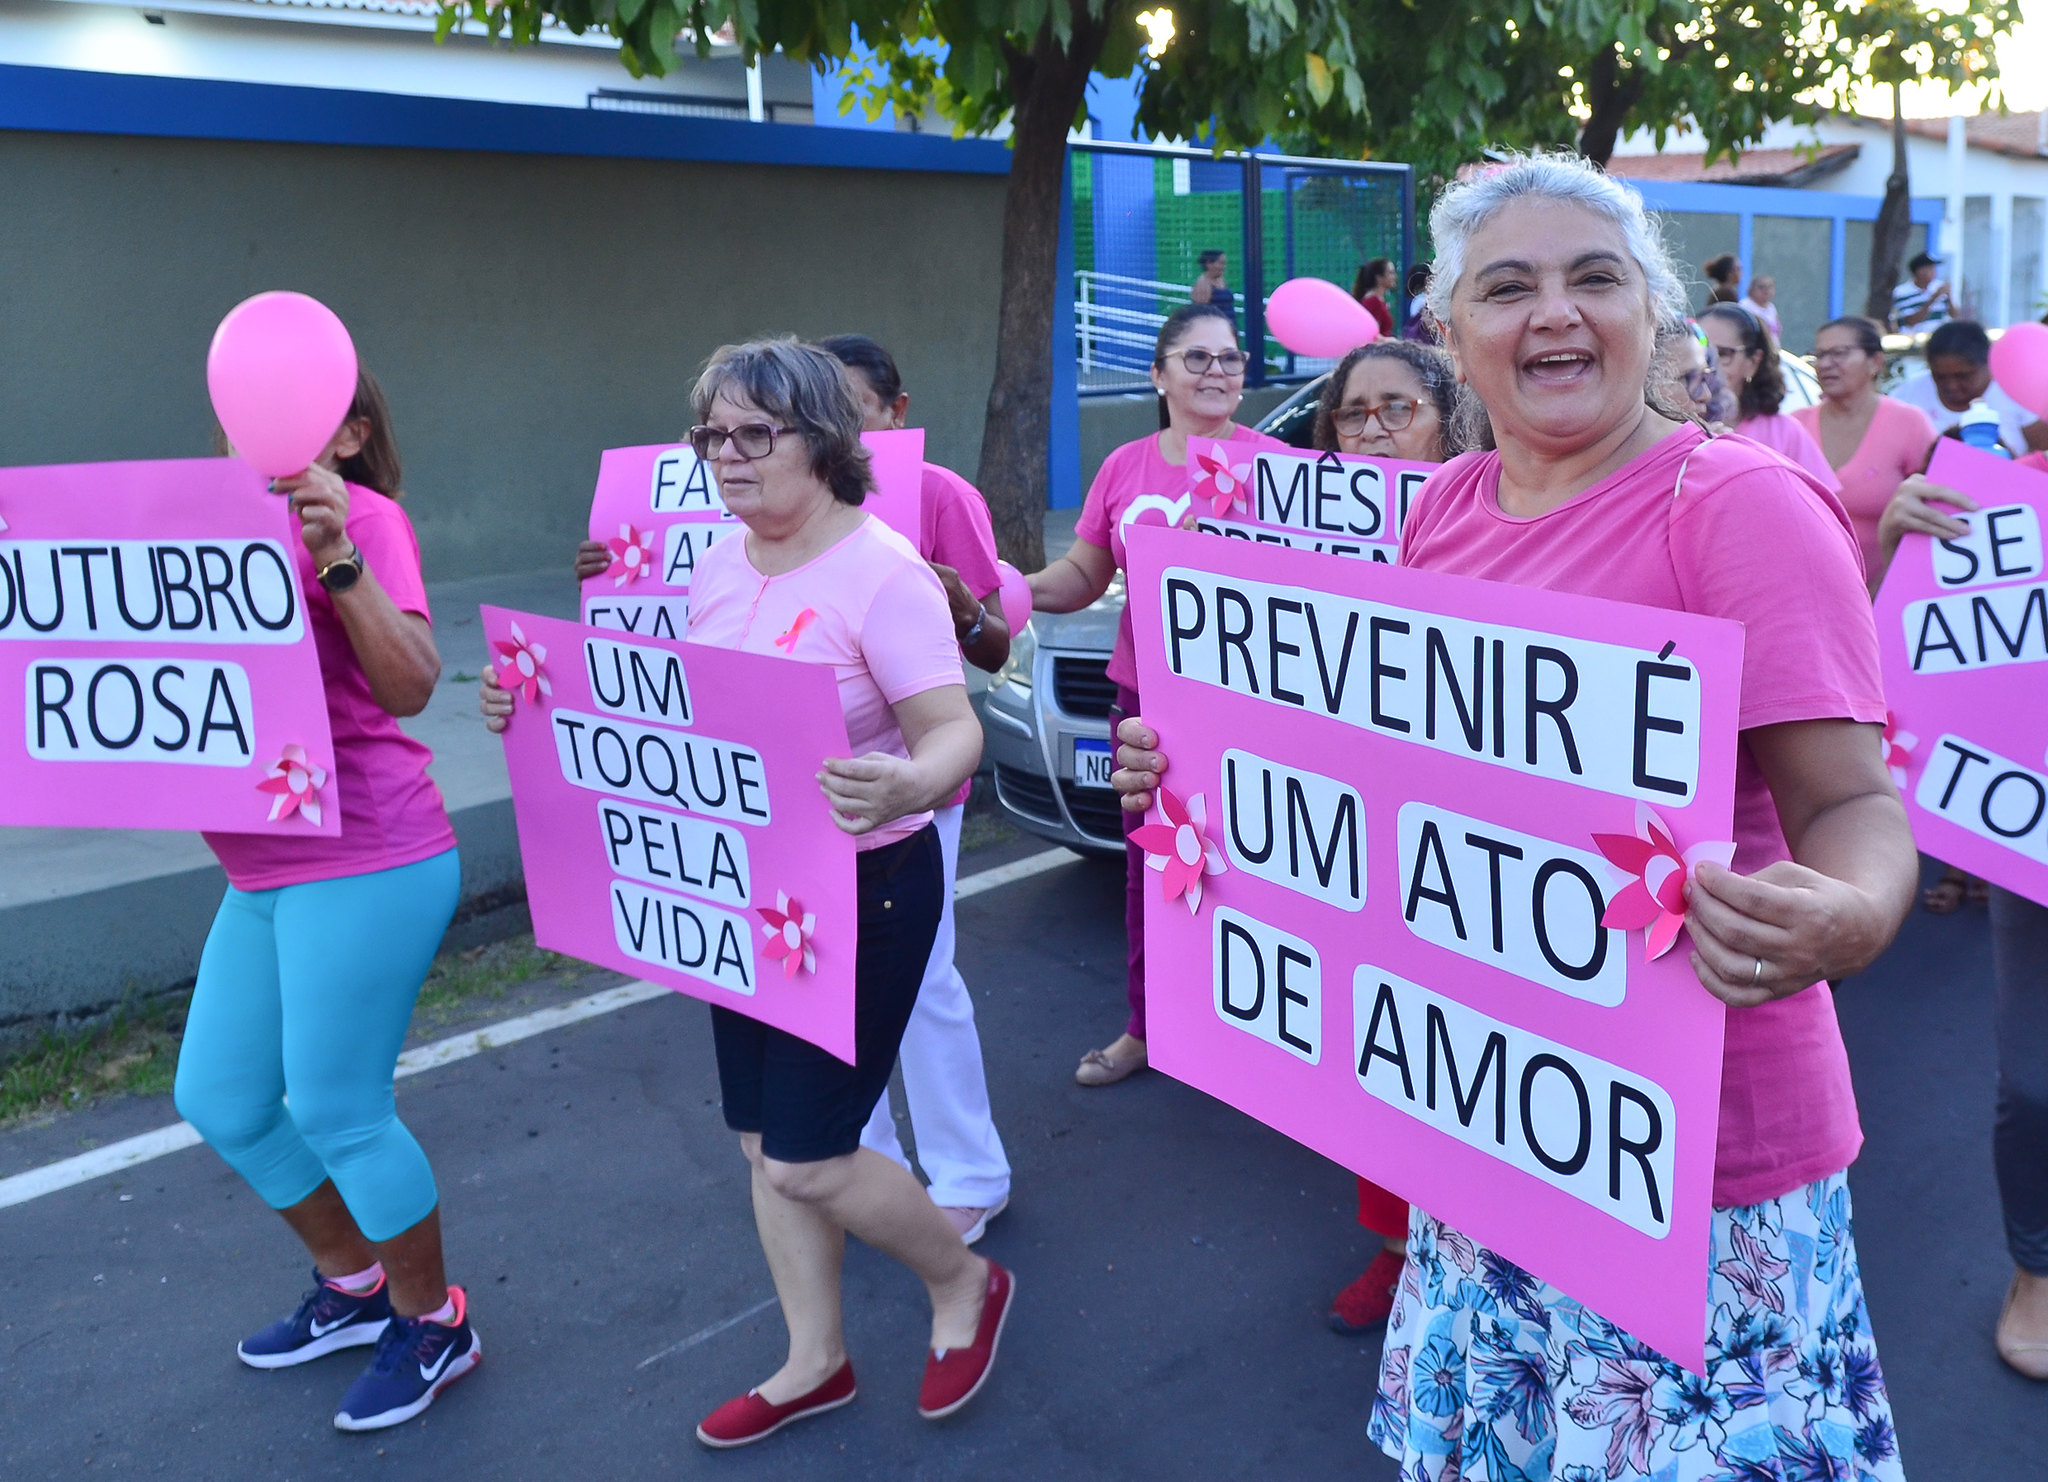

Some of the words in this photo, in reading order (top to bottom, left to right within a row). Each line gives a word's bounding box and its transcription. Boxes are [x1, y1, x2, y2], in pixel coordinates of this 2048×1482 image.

[655, 459, 732, 517] FA
[1257, 451, 1381, 536] MÊS
[1938, 508, 2032, 585] SE
[36, 664, 249, 755] ROSA
[587, 643, 689, 720] UM
[1166, 578, 1582, 775] PREVENIR
[1633, 640, 1690, 796] É
[556, 718, 767, 818] TOQUE
[603, 807, 746, 899] PELA
[1227, 758, 1360, 899] UM
[1405, 820, 1608, 981] ATO
[615, 888, 750, 986] VIDA
[1221, 919, 1312, 1055] DE
[1358, 982, 1664, 1223] AMOR
